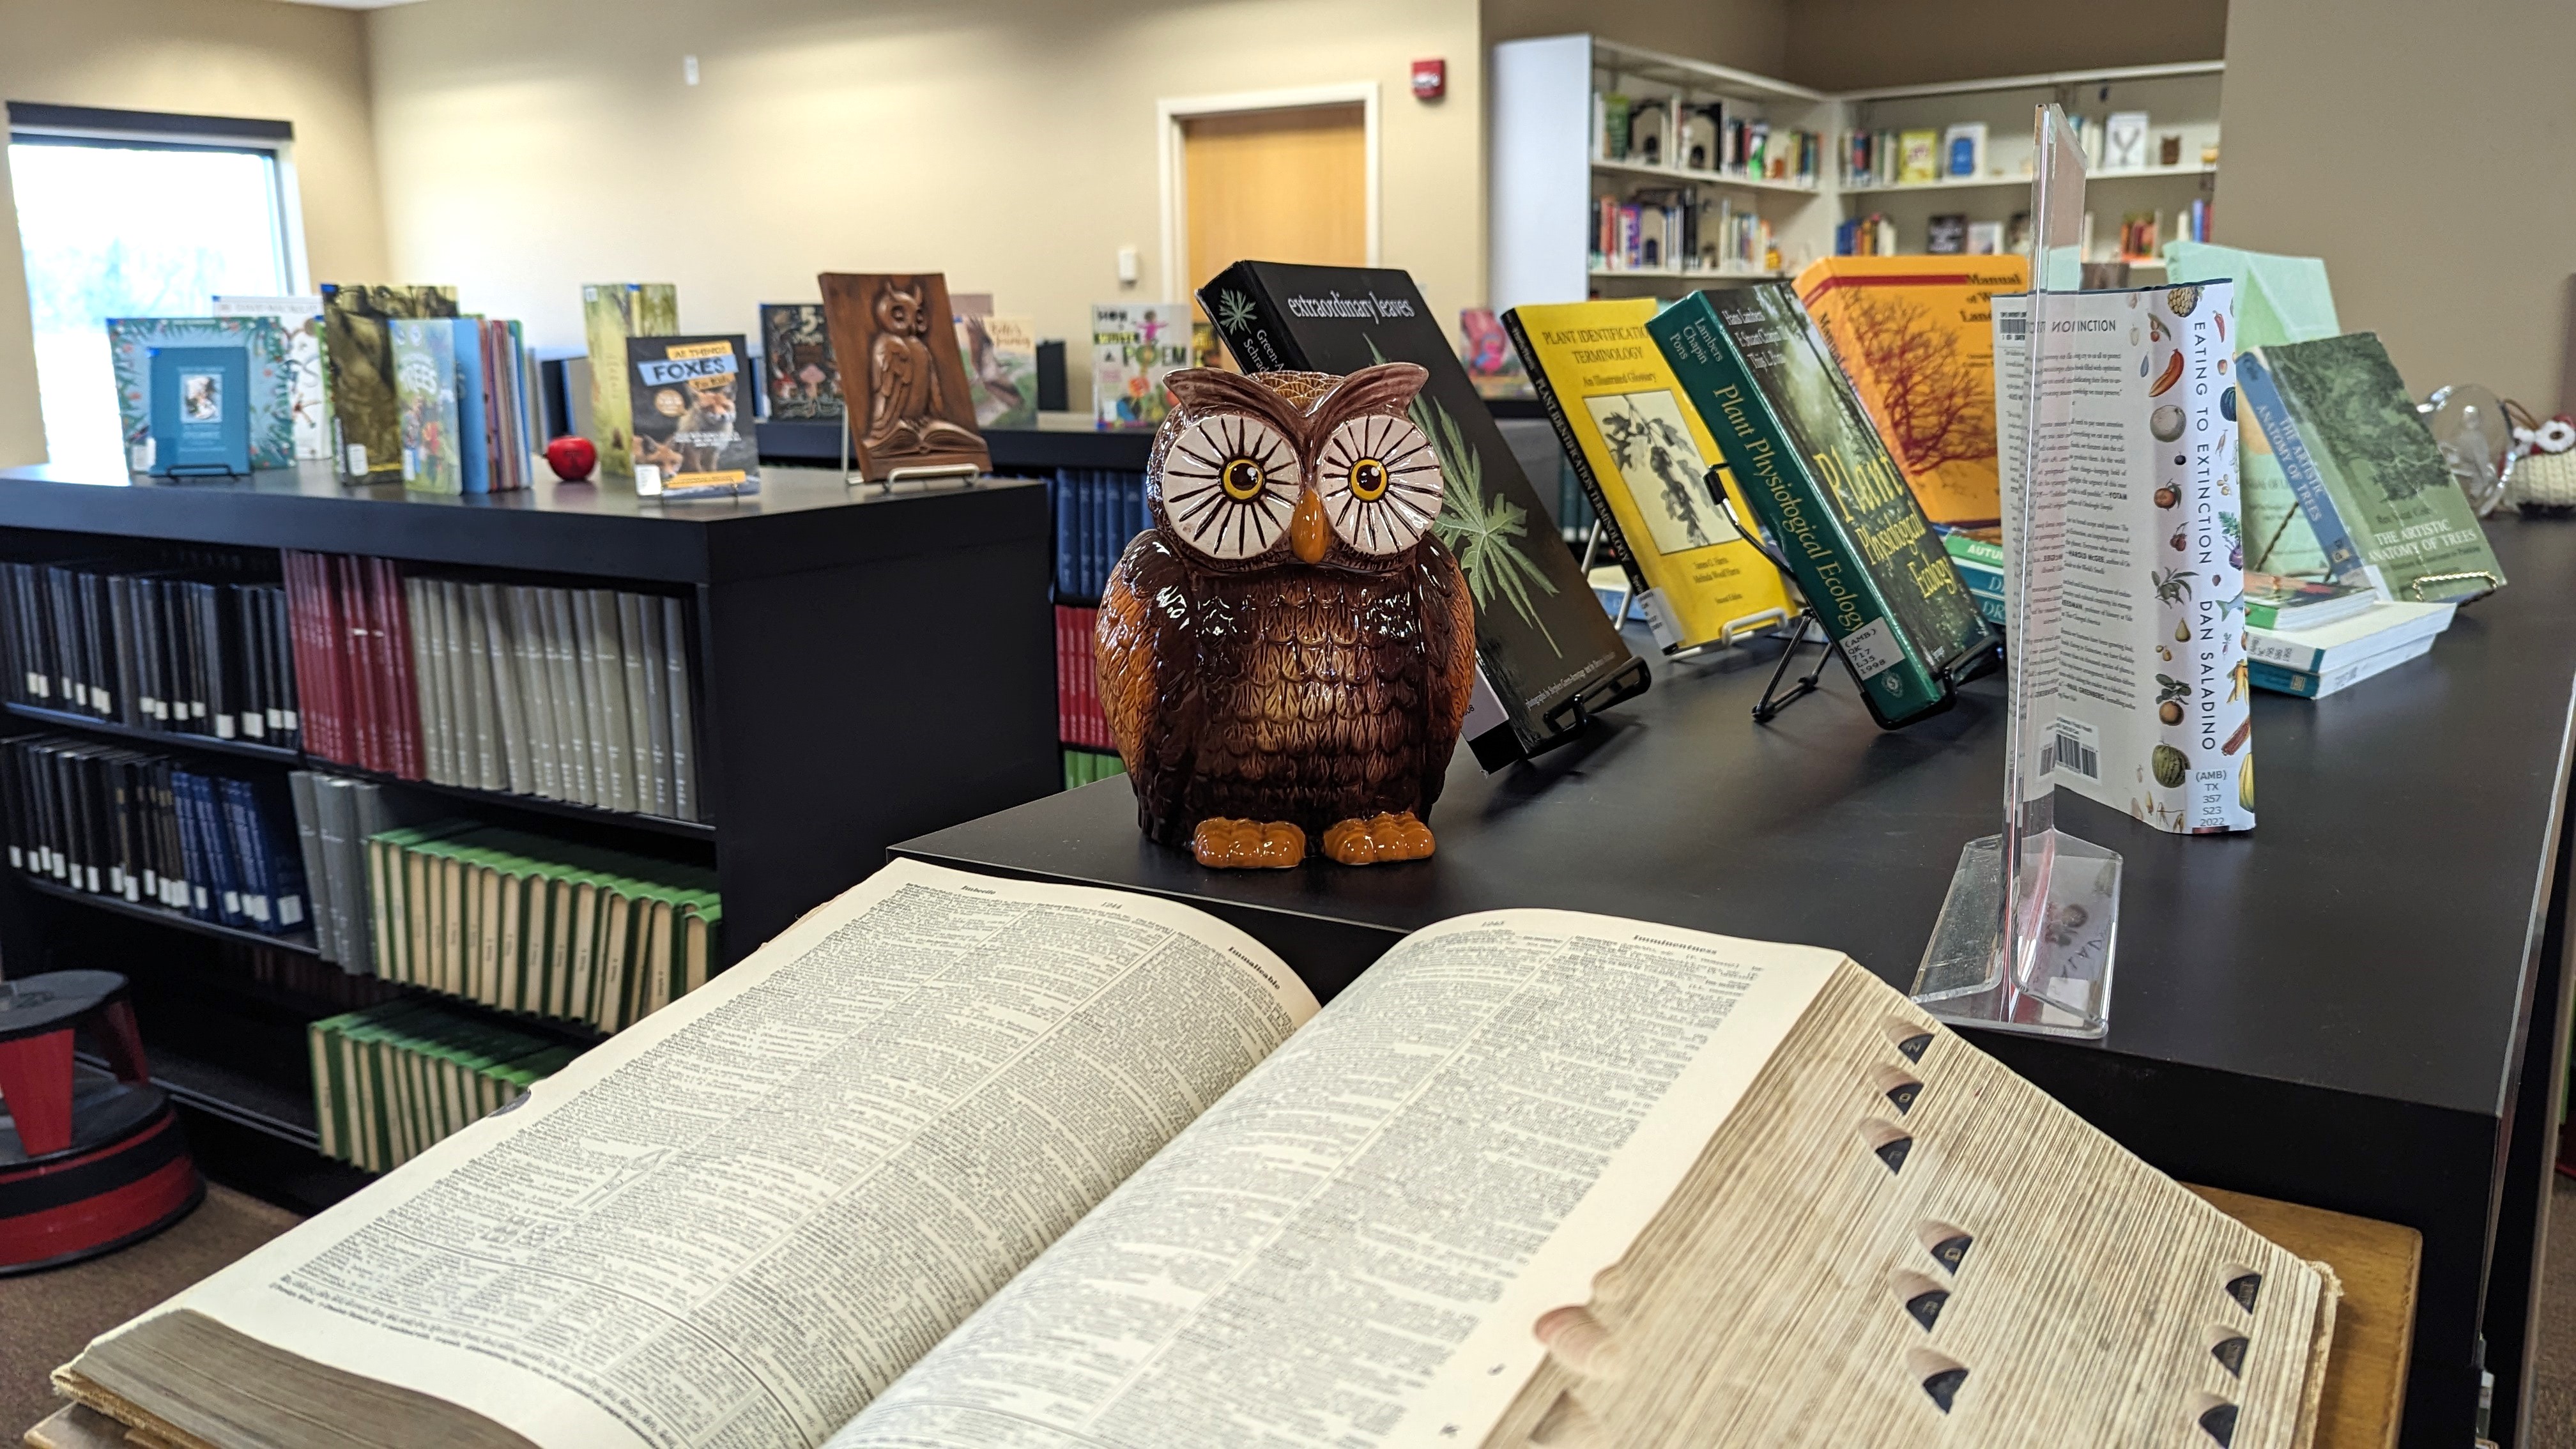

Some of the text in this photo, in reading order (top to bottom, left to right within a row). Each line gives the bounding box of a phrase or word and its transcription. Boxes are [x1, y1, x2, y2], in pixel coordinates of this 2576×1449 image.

[1966, 273, 2022, 286] Manual
[1287, 290, 1416, 325] extraordinary leaves
[1542, 331, 1575, 345] PLANT
[1669, 332, 1688, 360] Pons
[1683, 325, 1708, 364] Chapin
[1694, 318, 1723, 362] Lambers
[1571, 346, 1644, 364] TERMINOLOGY
[653, 357, 726, 381] FOXES
[2194, 321, 2212, 564] EATING TO EXTINCTION
[2256, 404, 2292, 462] ANATOMY
[2287, 464, 2303, 480] OF
[2297, 483, 2323, 522] TREES
[2280, 417, 2324, 498] THE ARTISTIC
[1535, 378, 1630, 564] PLANT IDENTIFICATION TERMINOLOGY
[1813, 444, 1903, 523] Plant
[1712, 383, 1865, 632] Plant Physiological Ecology
[2374, 519, 2452, 546] THE ARTISTIC
[1967, 544, 2002, 560] AUTU
[2368, 543, 2420, 562] ANATOMY
[2421, 536, 2438, 551] OF
[2439, 528, 2478, 547] TREES
[1845, 629, 1876, 647] (AMB)
[1852, 648, 1871, 661] 717
[1855, 655, 1876, 668] L35
[1860, 659, 1886, 675] 1998
[2199, 600, 2217, 751] DAN SALADINO
[2195, 770, 2228, 782] (AMB)
[2206, 783, 2220, 792] TX
[2202, 794, 2222, 804] 357
[2202, 806, 2223, 816] S23
[2199, 818, 2225, 827] 2022
